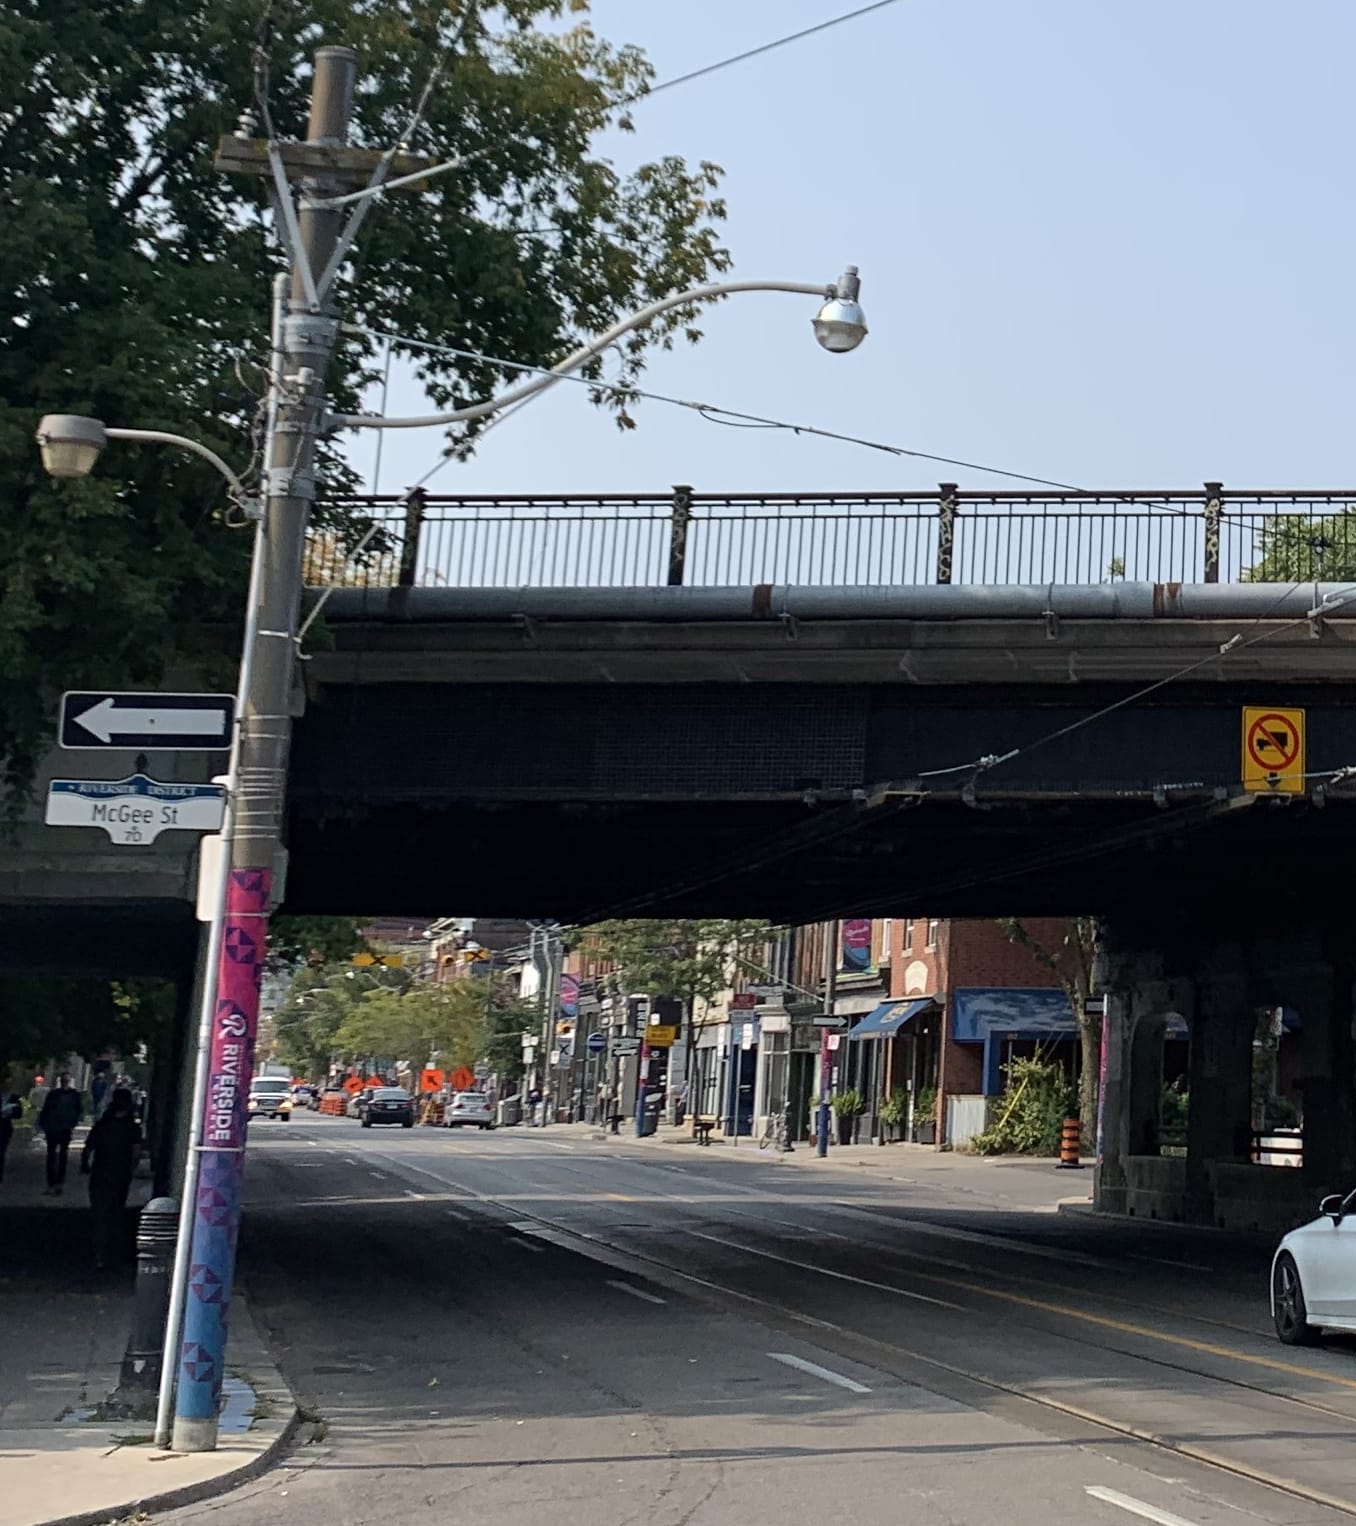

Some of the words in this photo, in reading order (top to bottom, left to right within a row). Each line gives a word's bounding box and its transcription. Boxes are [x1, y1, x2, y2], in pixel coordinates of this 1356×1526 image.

[79, 784, 136, 794] RIVERSIDE
[146, 786, 197, 796] DISTRICT
[91, 803, 154, 824] McGee
[160, 806, 178, 824] St
[214, 1043, 240, 1141] RIVERSIDE
